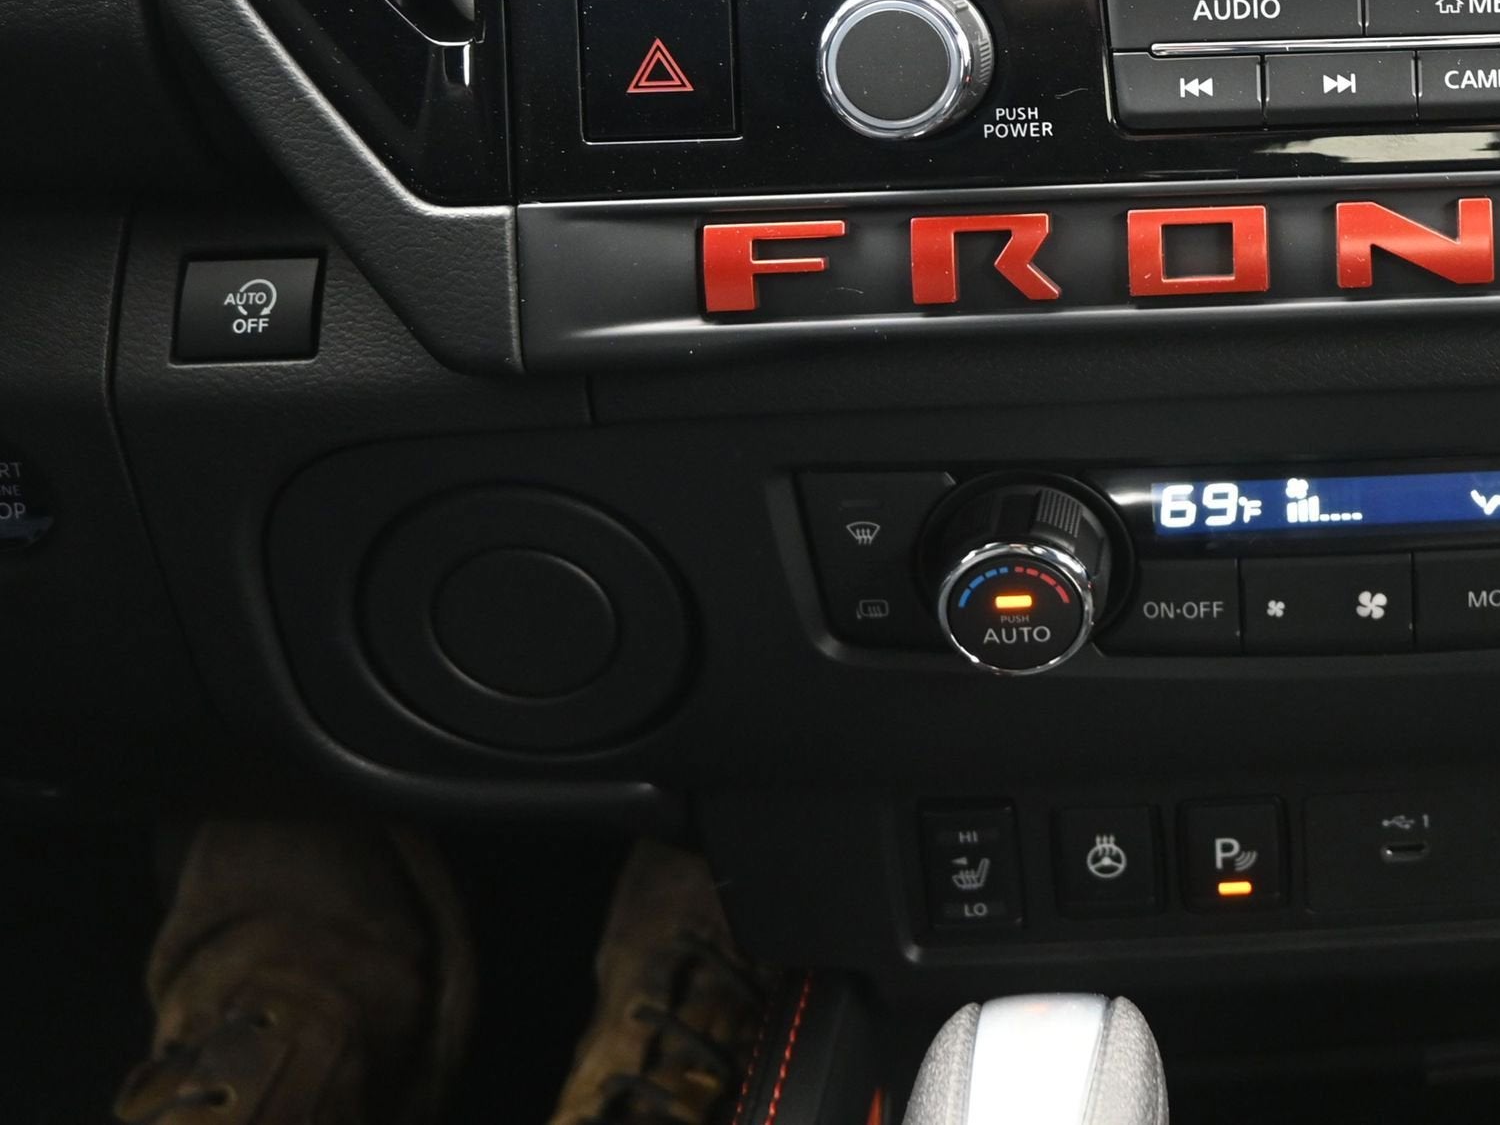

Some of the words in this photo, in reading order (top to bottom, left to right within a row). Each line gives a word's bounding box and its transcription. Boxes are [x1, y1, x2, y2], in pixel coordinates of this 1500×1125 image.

[995, 106, 1039, 121] PUSH
[983, 121, 1054, 139] POWER
[223, 291, 267, 305] AUTO
[232, 318, 270, 334] OFF
[983, 625, 1051, 644] AUTO
[958, 830, 978, 844] HI
[963, 902, 988, 918] LO
